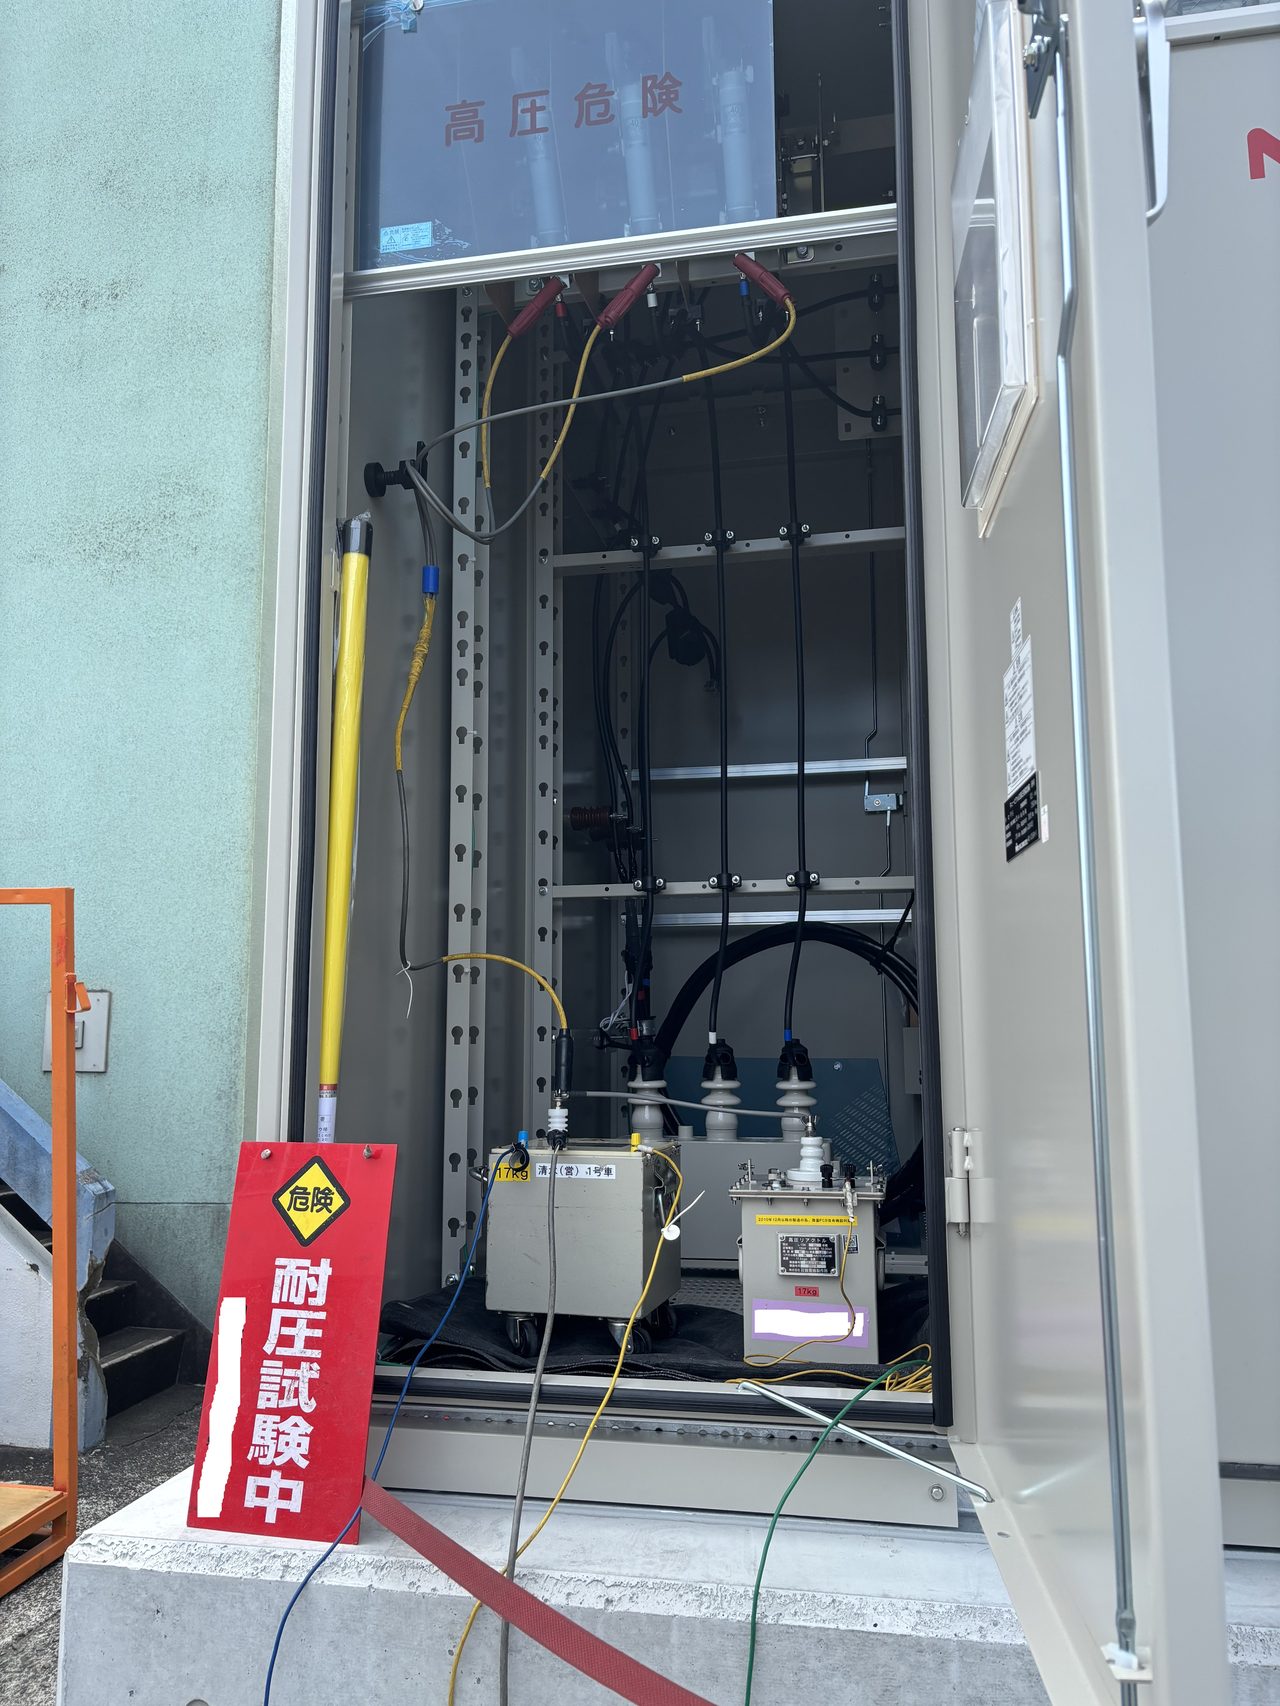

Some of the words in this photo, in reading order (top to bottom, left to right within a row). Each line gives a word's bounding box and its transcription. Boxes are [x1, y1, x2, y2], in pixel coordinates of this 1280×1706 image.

[444, 71, 684, 148] 高圧危険
[497, 1167, 528, 1181] 17kg
[287, 1185, 334, 1215] 危険
[798, 1287, 818, 1296] 17kg
[243, 1257, 333, 1525] 耐圧試験中
